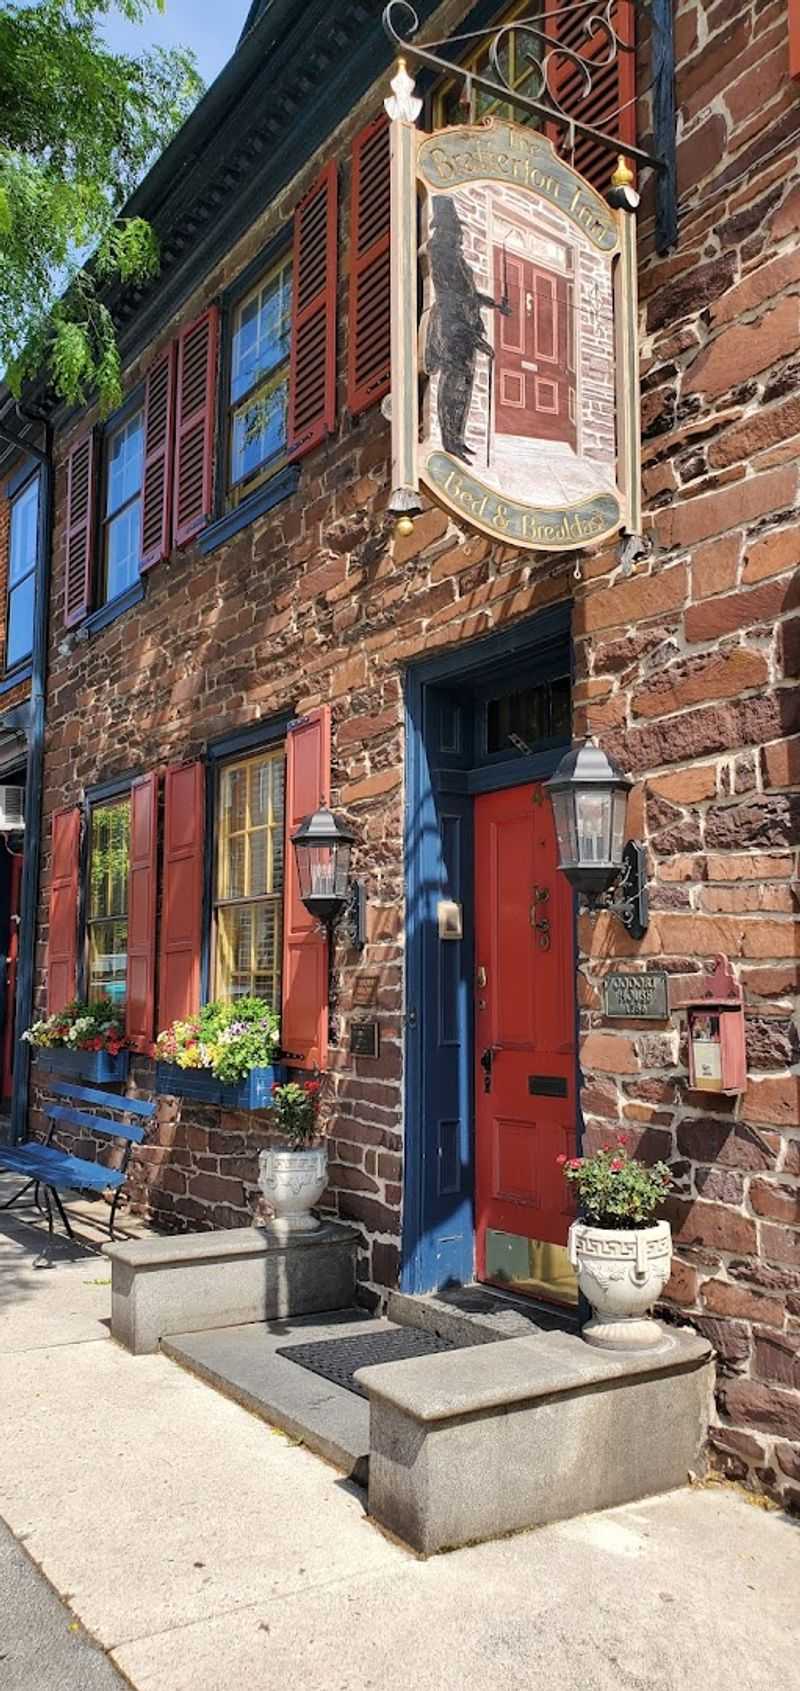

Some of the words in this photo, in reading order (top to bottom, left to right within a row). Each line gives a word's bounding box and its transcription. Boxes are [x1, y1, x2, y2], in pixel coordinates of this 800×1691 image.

[507, 125, 541, 155] The
[569, 186, 609, 242] Inn
[444, 472, 488, 517] Bed
[492, 504, 511, 529] &
